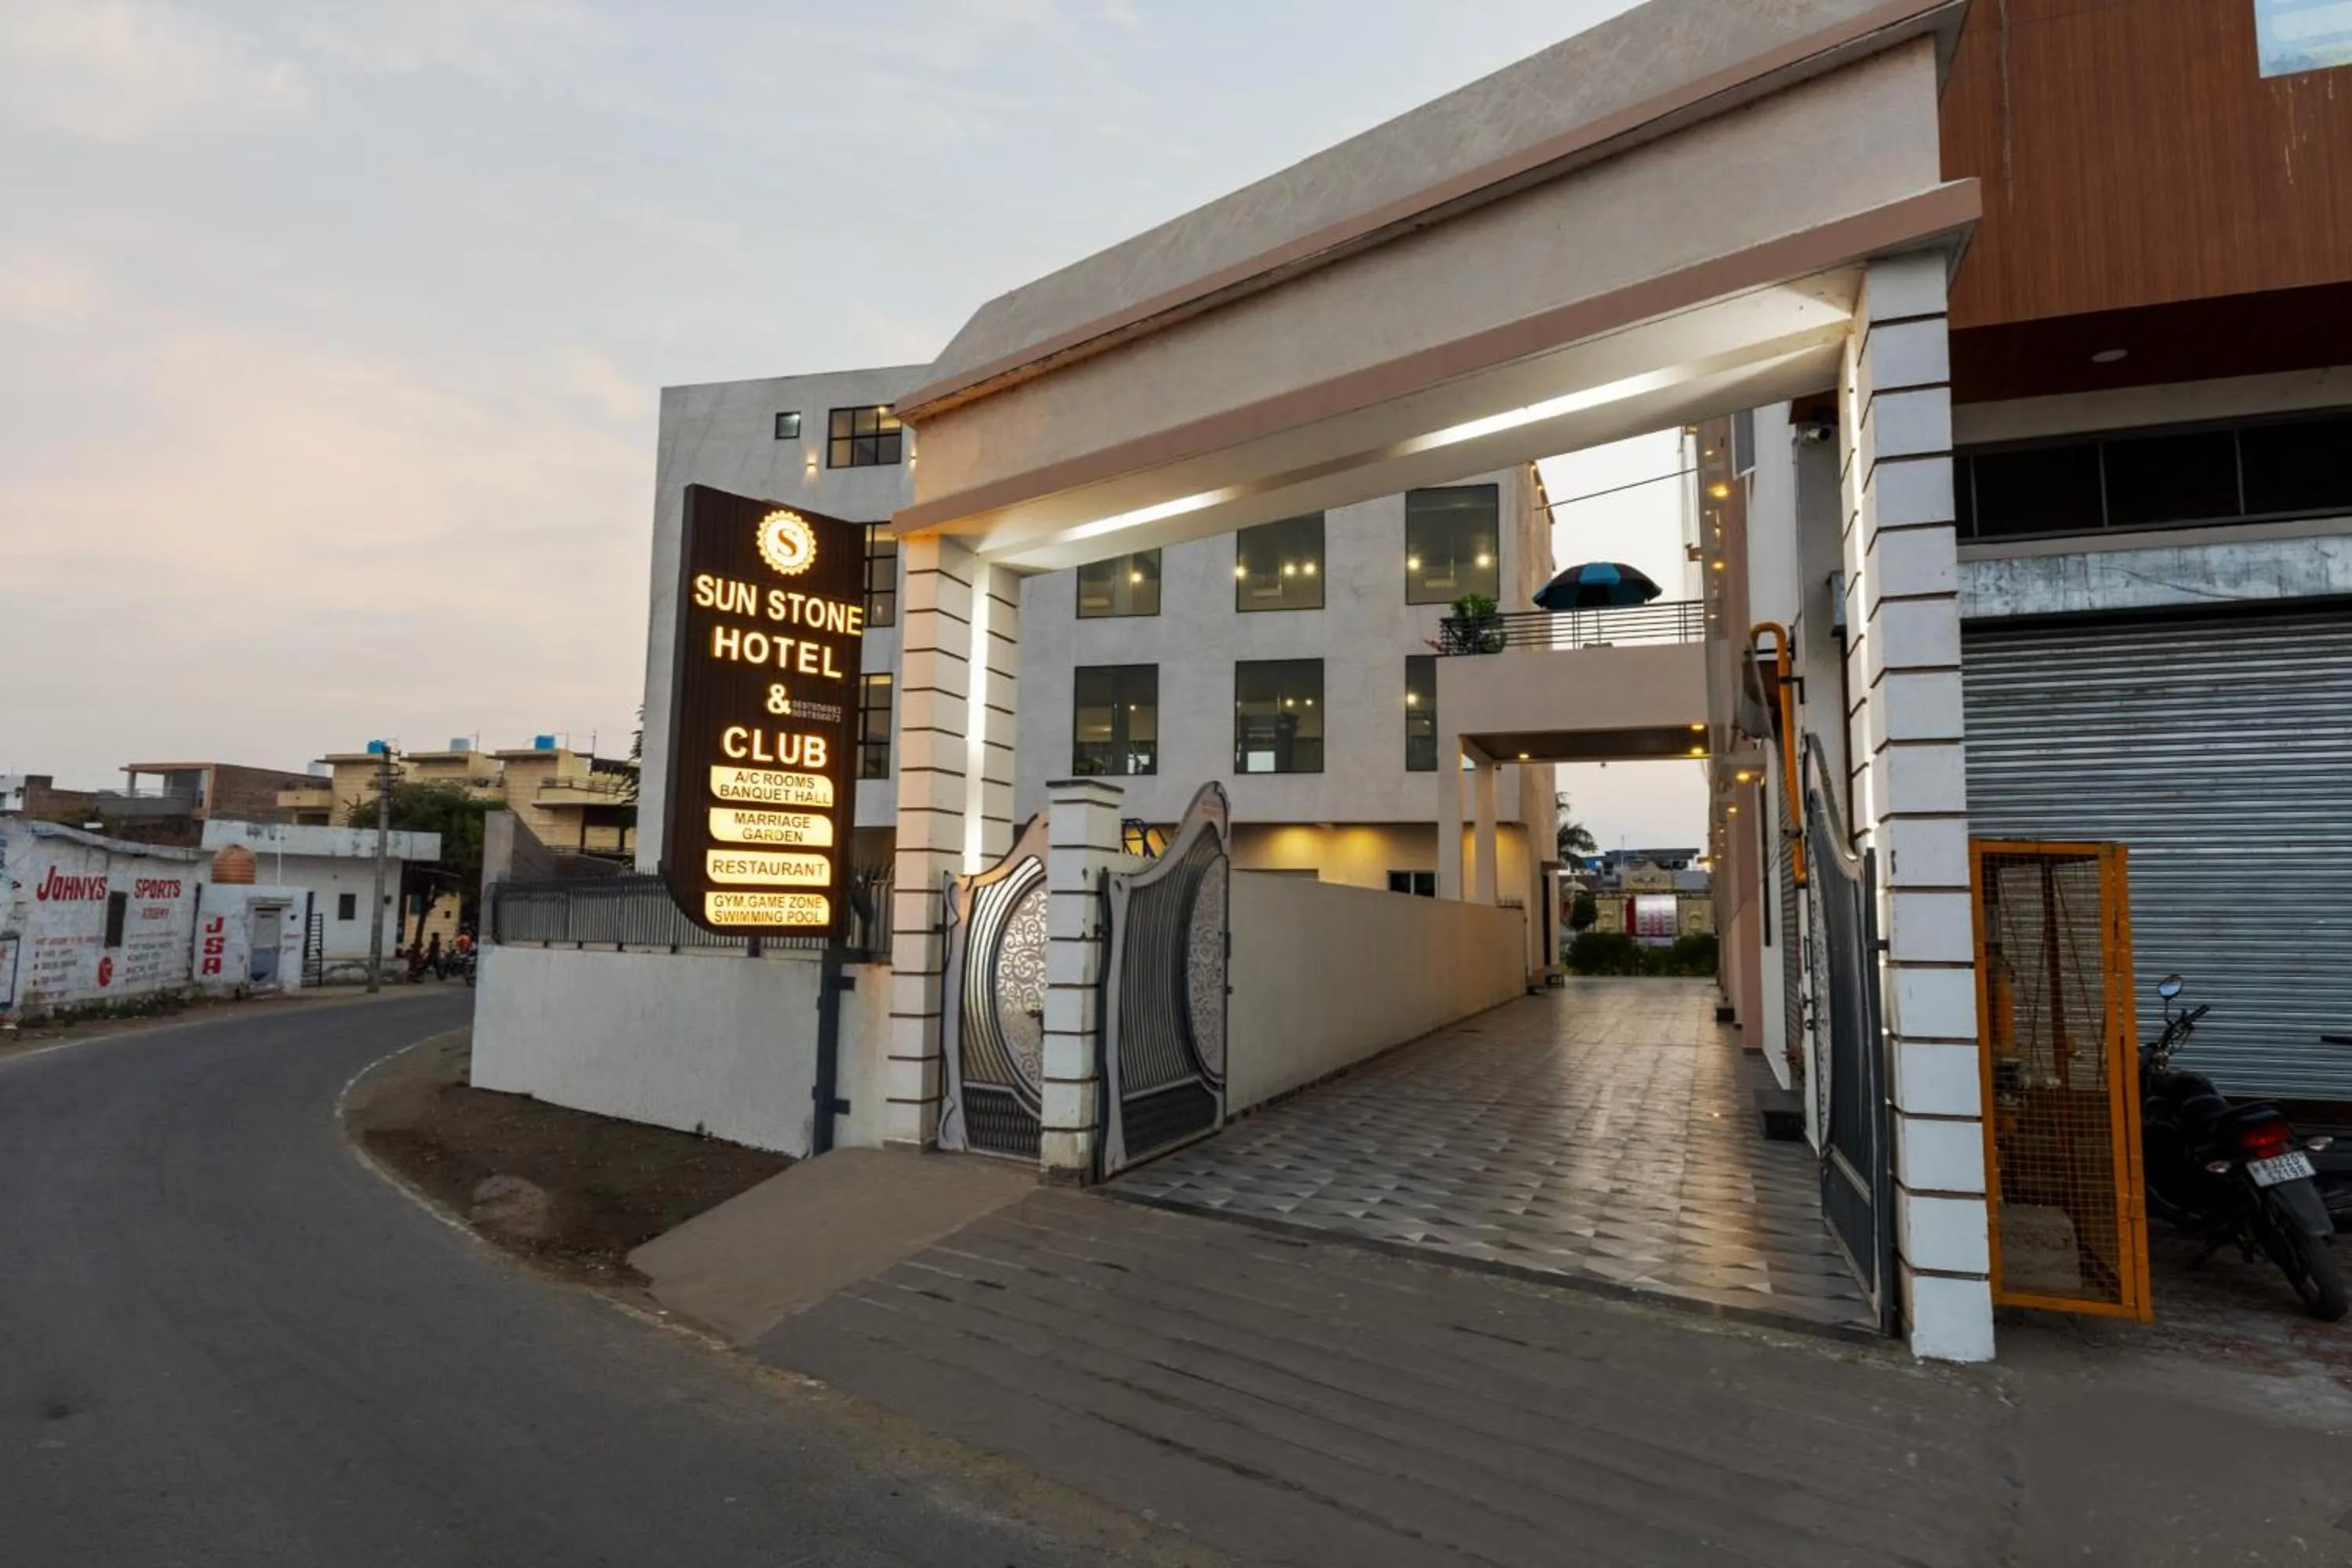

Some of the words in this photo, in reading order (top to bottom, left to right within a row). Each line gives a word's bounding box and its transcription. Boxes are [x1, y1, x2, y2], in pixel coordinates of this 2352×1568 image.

[695, 574, 757, 617] SUN
[767, 589, 863, 636] STONE
[713, 625, 843, 679] HOTEL
[767, 683, 791, 714] &
[722, 726, 827, 768] CLUB
[734, 771, 760, 784] A/C
[763, 773, 815, 789] ROOMS
[719, 784, 790, 801] BANQUET
[794, 790, 831, 804] HALL
[734, 812, 811, 829] MARRIAGE
[742, 827, 804, 843] GARDEN
[712, 858, 826, 877] RESTAURANT
[134, 878, 182, 899] SPORTS
[789, 896, 823, 909] ZONE
[713, 910, 784, 924] SWIMMING
[786, 910, 823, 924] POOL
